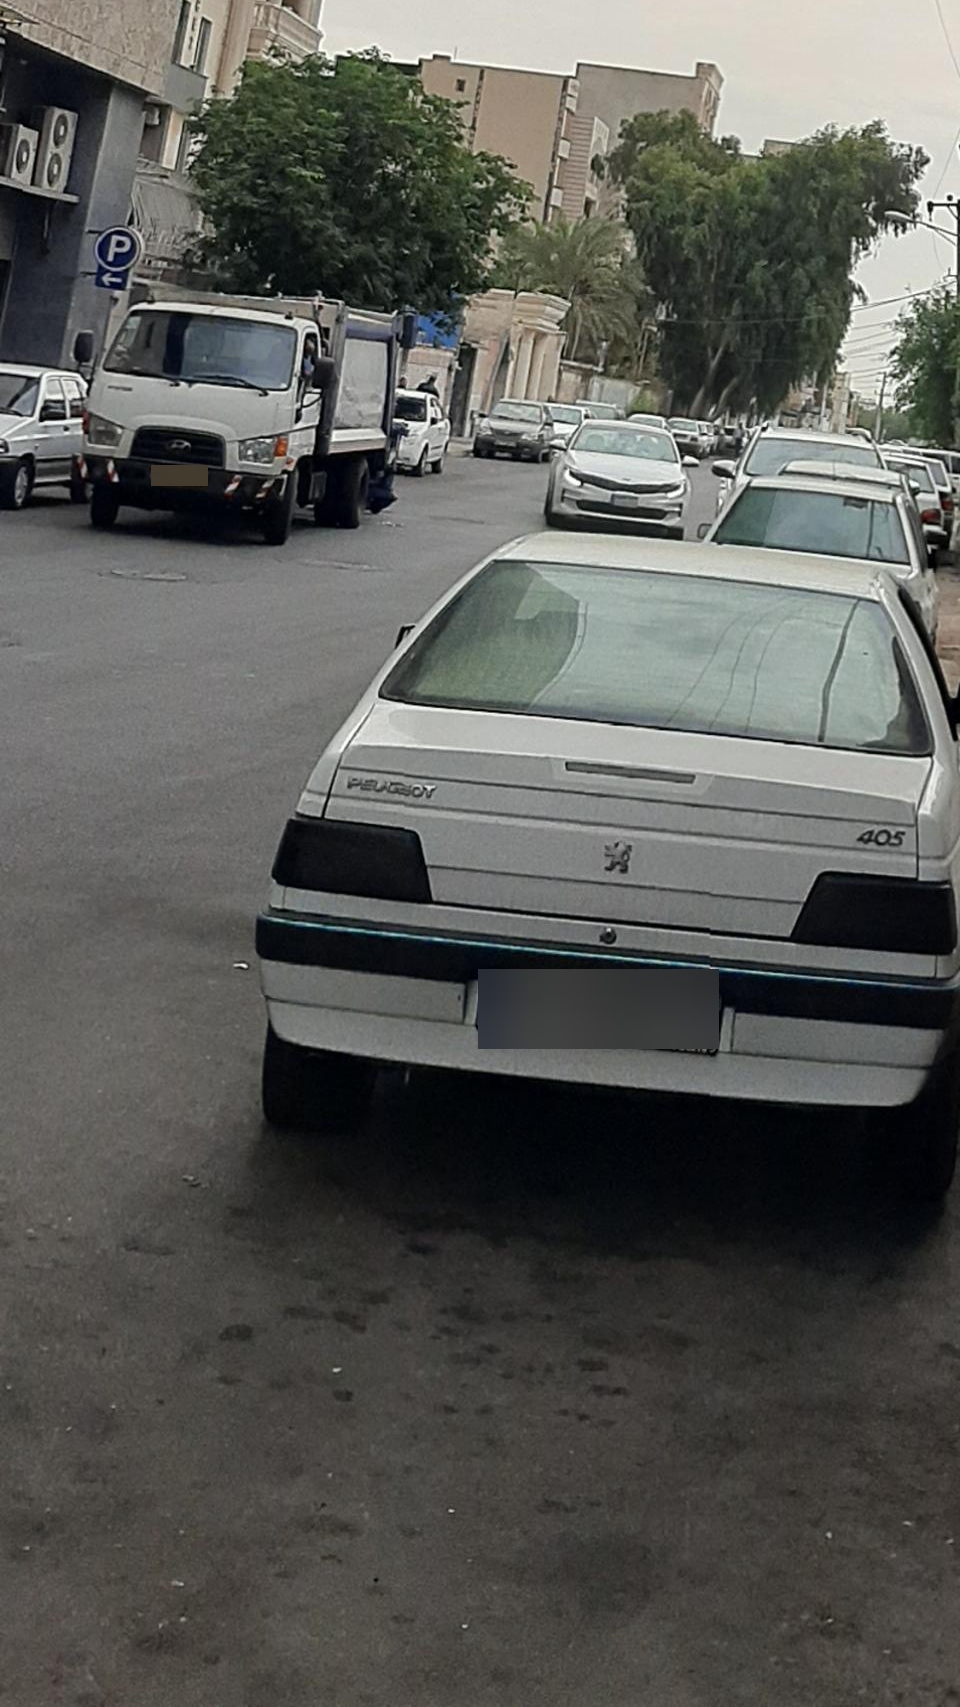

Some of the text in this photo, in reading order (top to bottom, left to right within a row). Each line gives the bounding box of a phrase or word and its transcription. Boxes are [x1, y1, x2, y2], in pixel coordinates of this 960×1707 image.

[107, 234, 132, 263] P
[346, 775, 437, 799] PEUGEOT
[856, 828, 906, 847] 405
